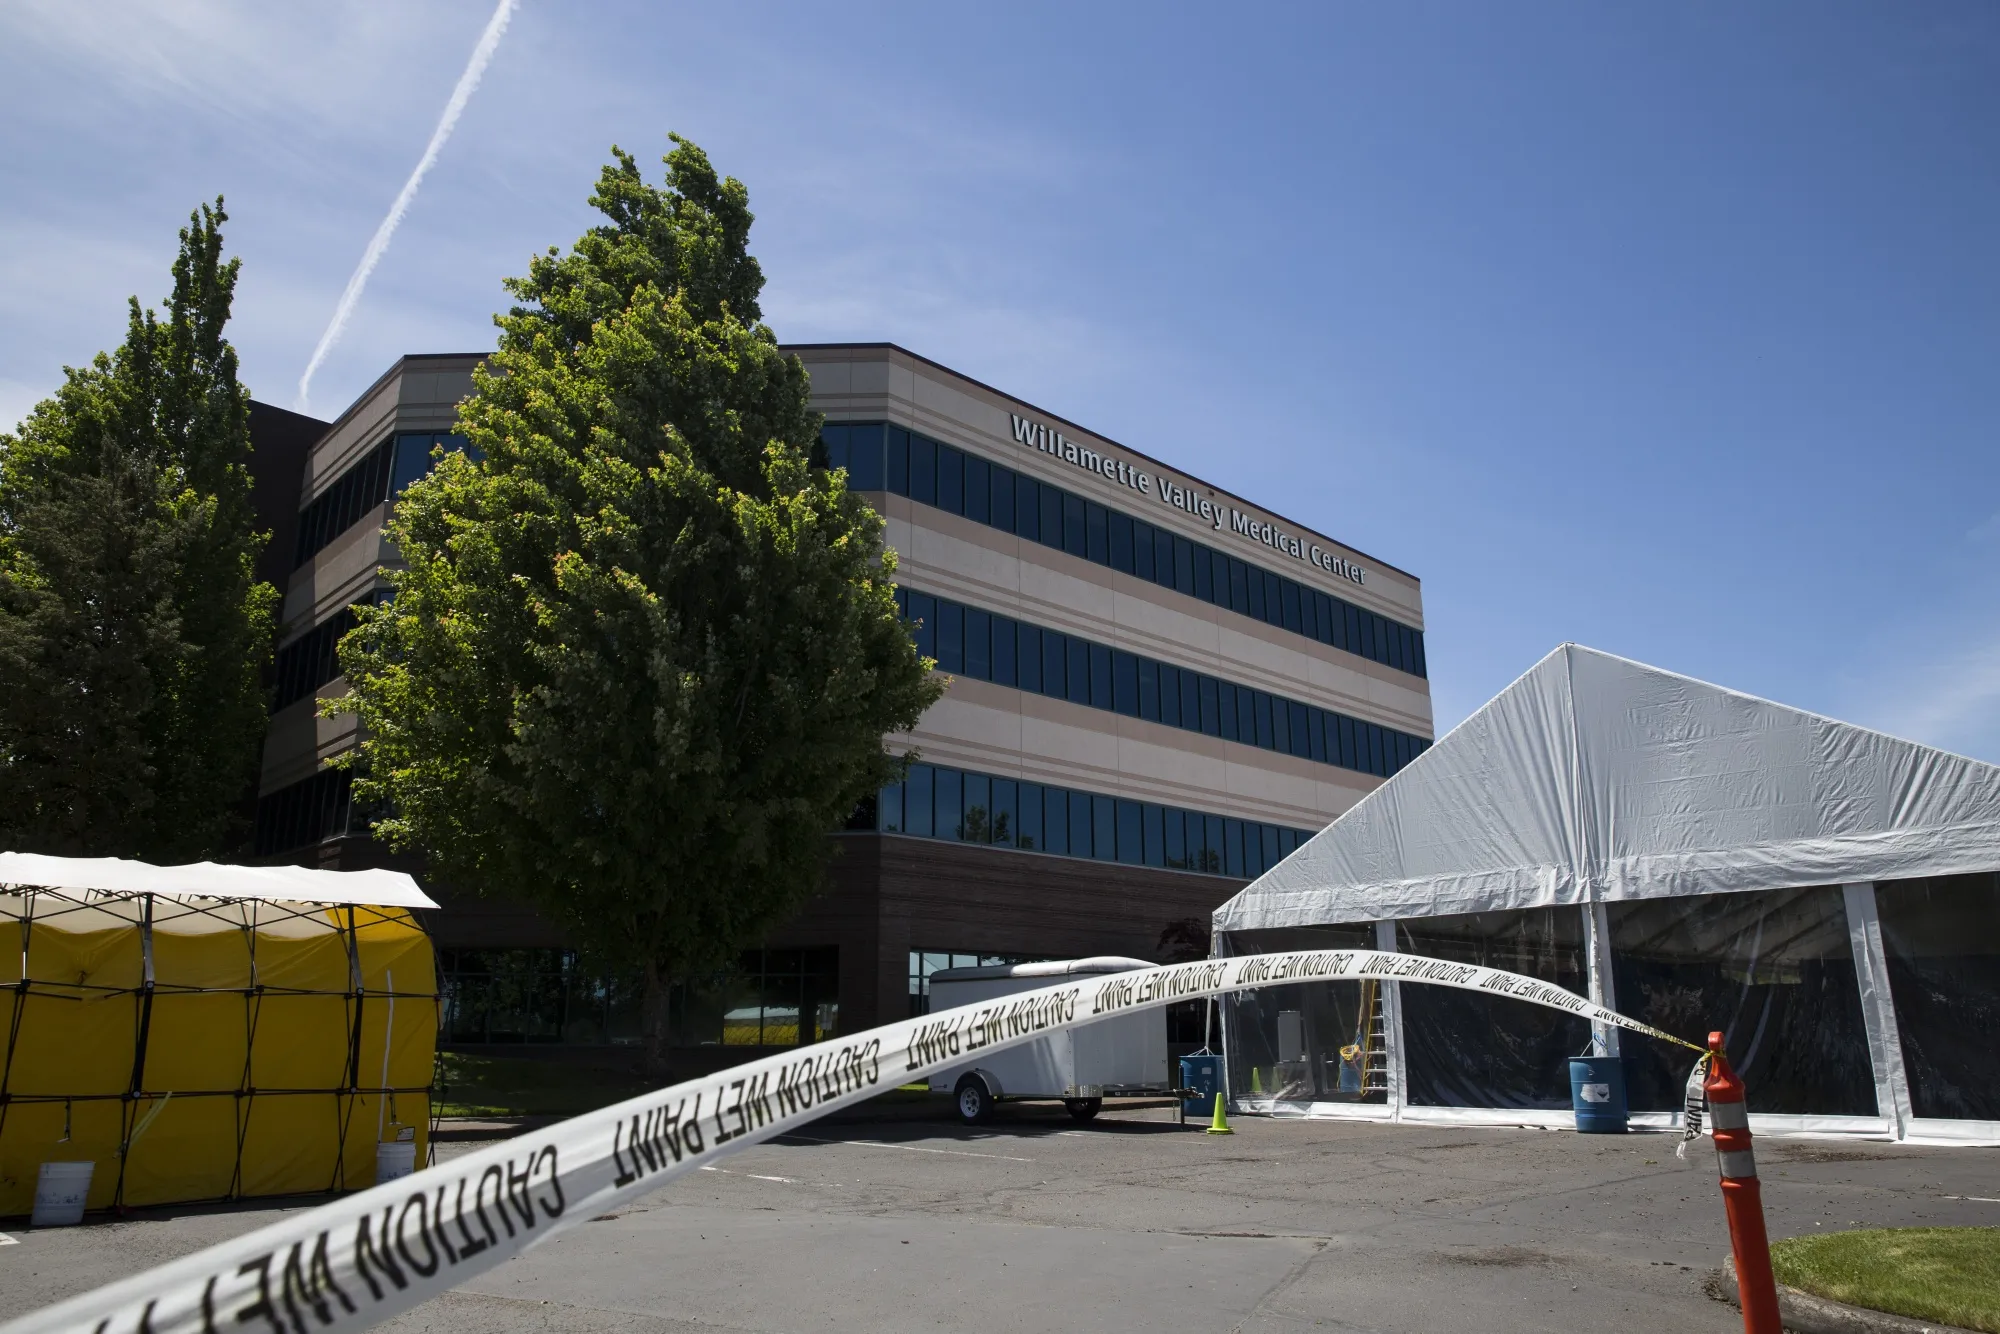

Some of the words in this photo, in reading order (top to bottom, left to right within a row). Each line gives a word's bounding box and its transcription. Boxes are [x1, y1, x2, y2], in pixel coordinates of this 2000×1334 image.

[1011, 414, 1150, 494] Willamette
[1157, 477, 1224, 530] Valley
[1231, 508, 1306, 561] Medical
[1311, 545, 1367, 585] Center
[1168, 962, 1228, 997] CAUTION
[1235, 957, 1277, 984] PAINT
[1272, 955, 1303, 980] WET
[1299, 953, 1354, 977] CAUTION
[1359, 954, 1402, 974] PAINT
[1393, 958, 1428, 977] WET
[1421, 962, 1477, 984] CAUTION
[1479, 972, 1520, 993] PAINT
[1092, 976, 1140, 1015] PAINT
[1136, 971, 1171, 1004] WET
[966, 1005, 1006, 1052] WET
[1007, 988, 1080, 1039] CAUTION
[906, 1015, 965, 1072] PAINT
[776, 1038, 880, 1118] CAUTION
[715, 1071, 774, 1145] WET
[1684, 1094, 1703, 1141] PAINT
[614, 1093, 704, 1189] PAINT
[356, 1145, 565, 1302] CAUTION
